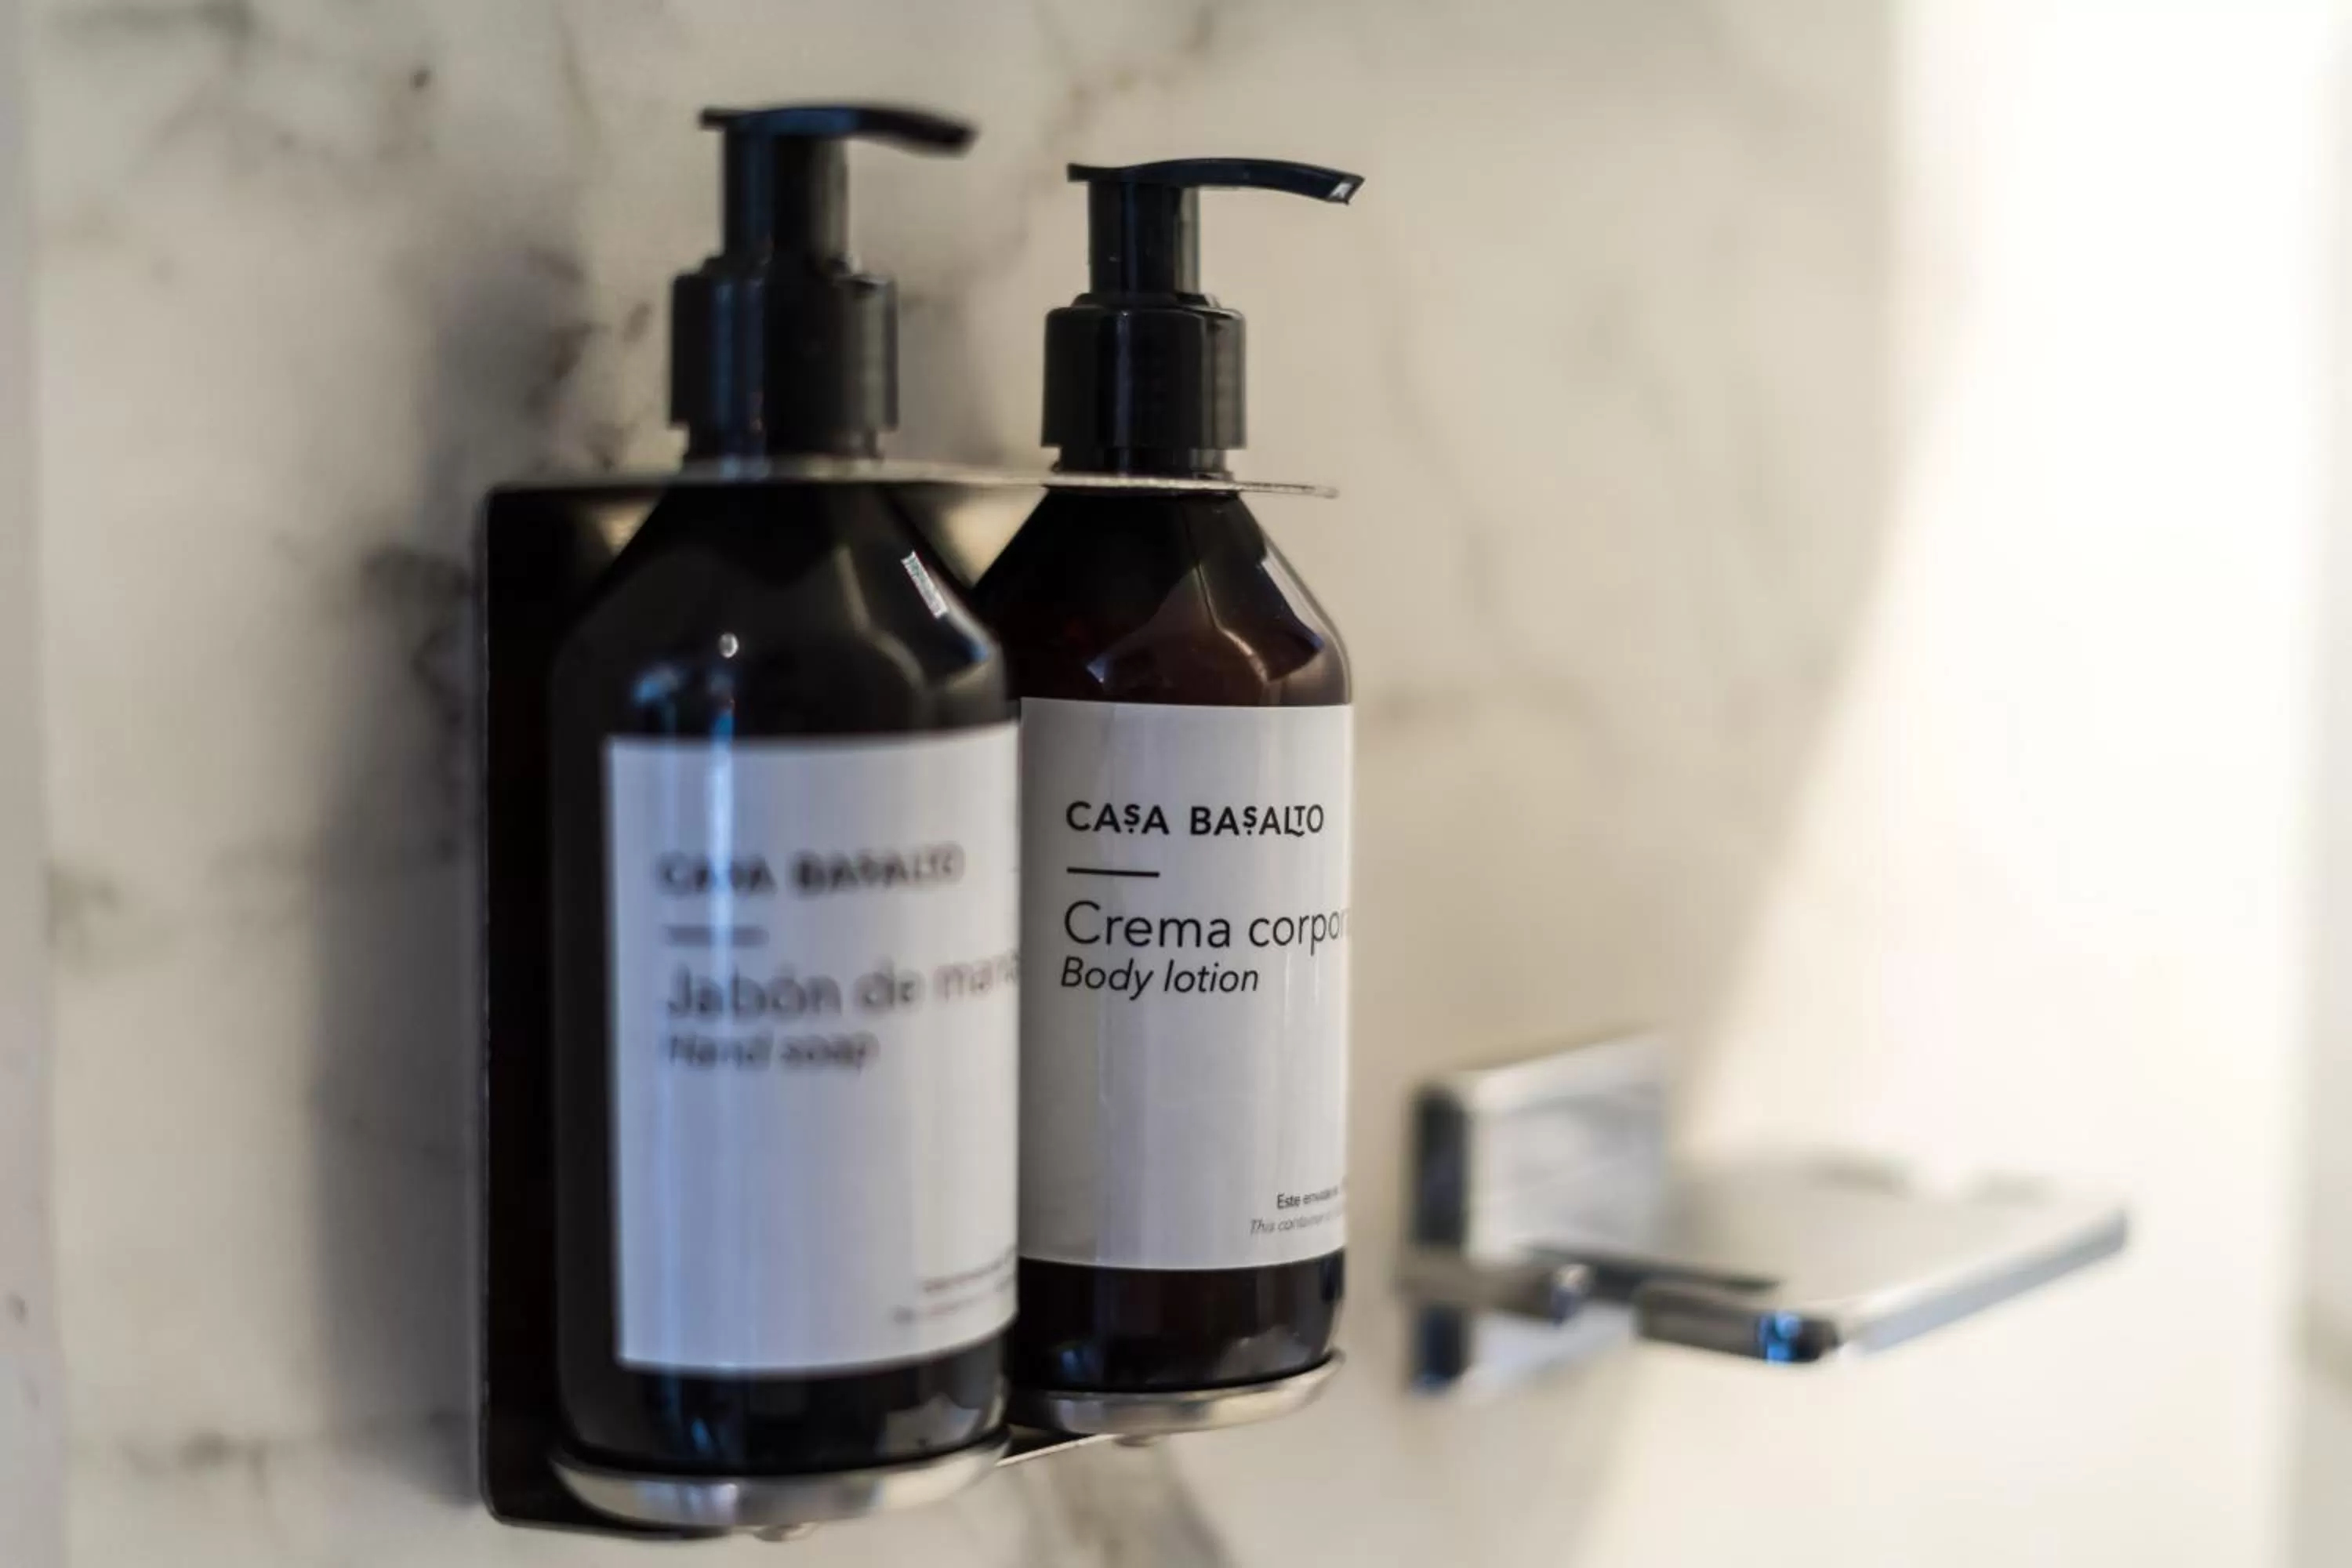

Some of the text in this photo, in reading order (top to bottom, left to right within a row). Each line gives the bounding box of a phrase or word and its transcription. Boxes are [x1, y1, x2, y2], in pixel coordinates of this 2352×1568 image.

[1065, 800, 1325, 837] CASA BASALTO
[1064, 899, 1231, 948] Crema
[1060, 955, 1259, 1001] Body lotion
[1276, 1192, 1301, 1210] Este
